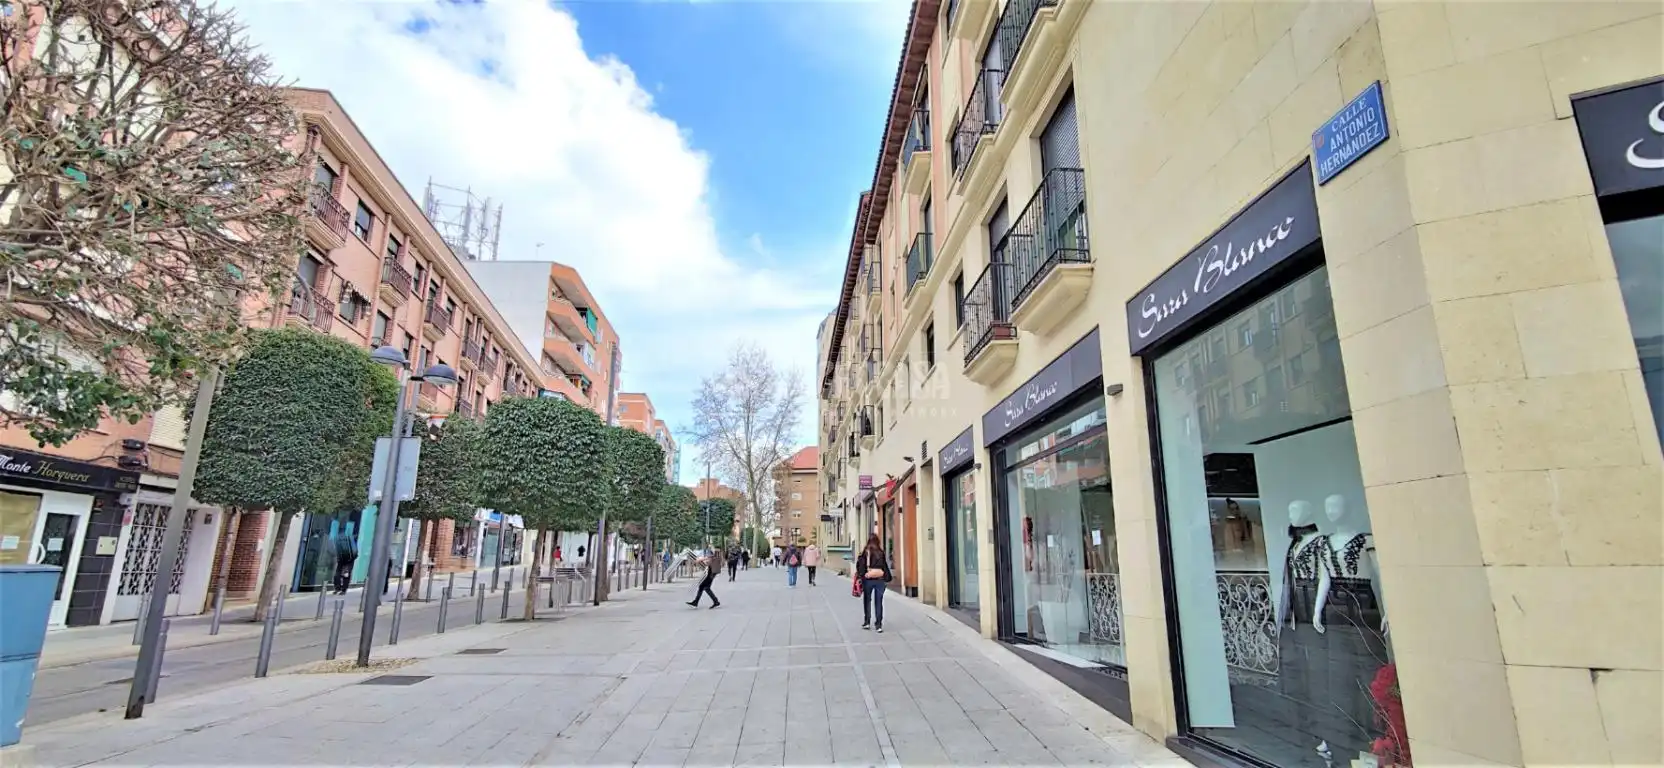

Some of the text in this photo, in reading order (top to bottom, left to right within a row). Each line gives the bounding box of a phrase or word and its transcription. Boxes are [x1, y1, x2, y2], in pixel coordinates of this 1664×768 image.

[1330, 107, 1376, 153] ANTONIO
[1331, 97, 1368, 133] CALLE
[1320, 122, 1381, 177] HERNANDEZ
[1138, 215, 1295, 338] Sara Blanco
